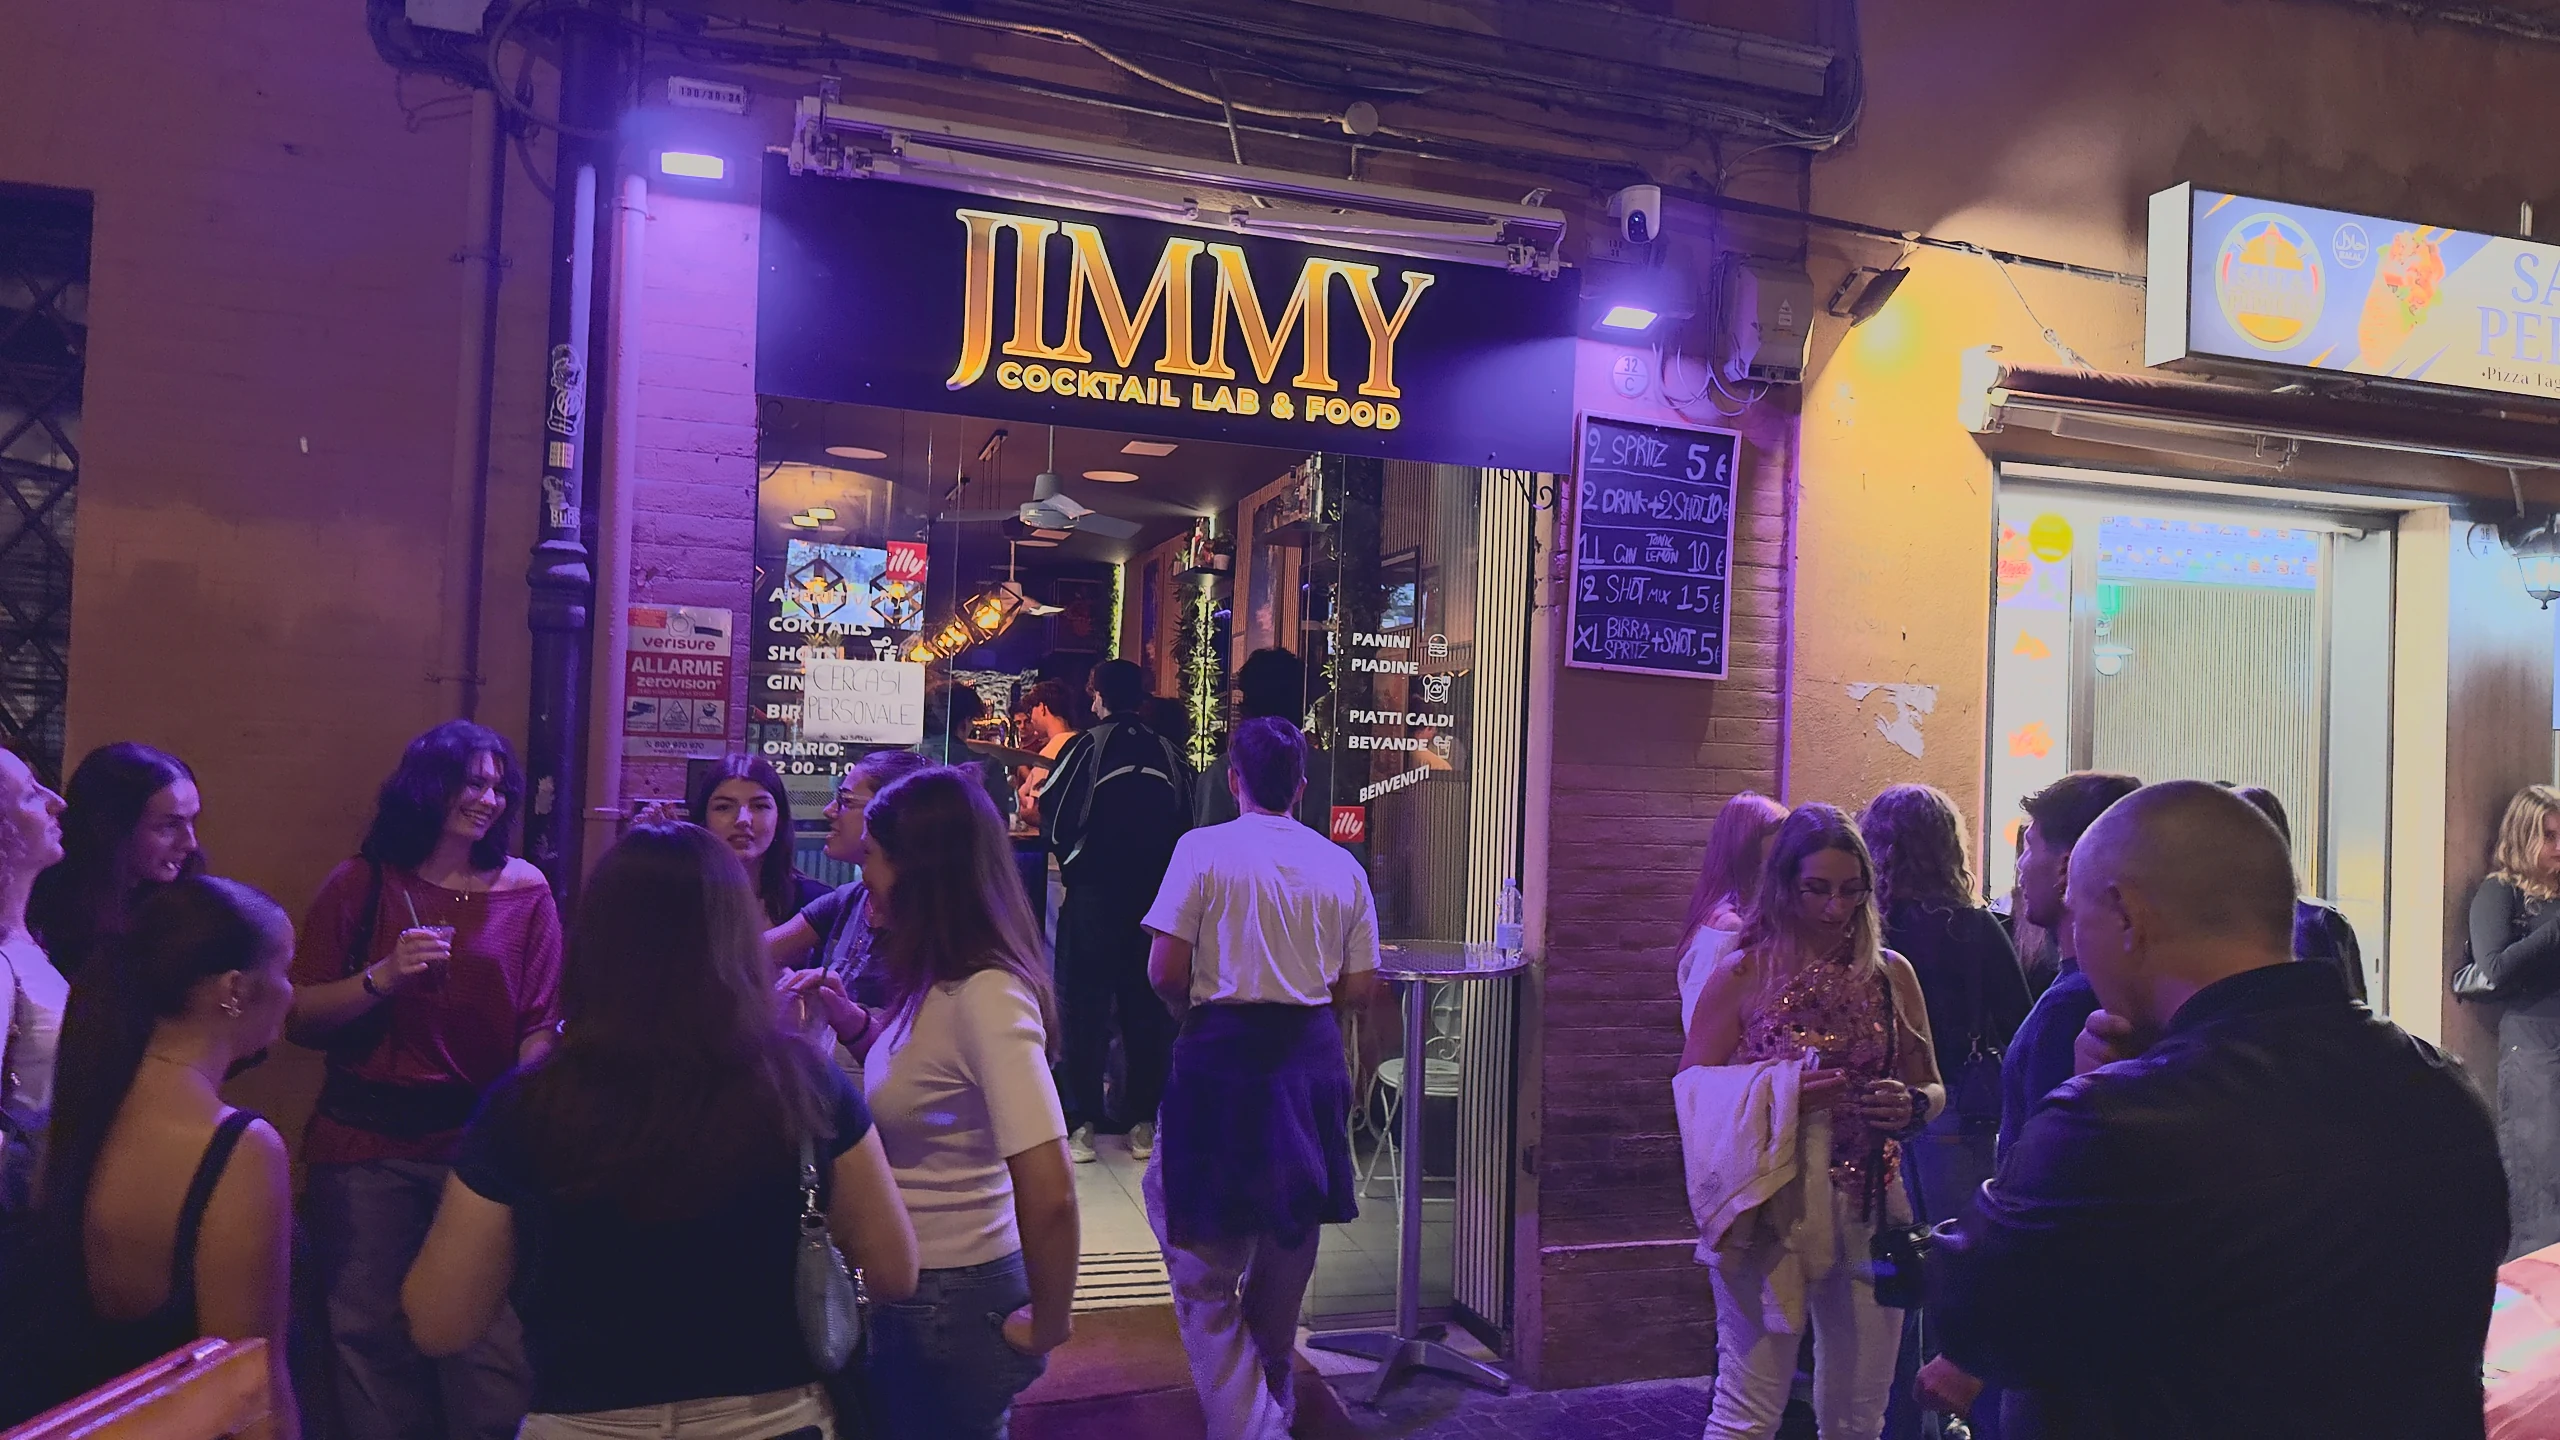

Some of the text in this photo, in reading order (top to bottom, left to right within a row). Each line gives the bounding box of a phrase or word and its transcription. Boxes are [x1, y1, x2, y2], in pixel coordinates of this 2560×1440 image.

[946, 208, 1436, 400] JIMMY
[1624, 357, 1638, 373] 32
[1625, 376, 1635, 392] C
[2487, 366, 2529, 385] Pizza
[996, 361, 1402, 432] COCKTAIL LAB & FOOD
[1587, 427, 1728, 482] 2 SPRITZ 5 €
[1582, 480, 1599, 511] 2
[1613, 543, 1638, 565] GIN
[1645, 532, 1675, 548] TONIC
[1687, 540, 1710, 573] 10
[1645, 550, 1680, 564] LEMON
[2482, 544, 2489, 556] A
[889, 548, 926, 578] illy
[1605, 573, 1651, 606] SHOT
[1647, 587, 1672, 606] MIX
[768, 617, 872, 637] COKTAILS
[642, 637, 716, 651] verisure
[1352, 632, 1411, 649] PANINI
[1574, 622, 1603, 653] XL
[1605, 615, 1651, 641] BIRRA
[1697, 631, 1717, 666] 5
[1604, 640, 1651, 661] SPRITZ
[632, 656, 724, 677] ALLARME
[1351, 658, 1419, 675] PIADINE
[767, 674, 804, 691] GIN
[812, 664, 903, 695] CERCASI
[766, 704, 803, 720] BIR
[807, 696, 917, 726] PERSONALE
[1350, 710, 1454, 728] PIATTI CALDI
[763, 741, 845, 756] ORARIO:
[1348, 736, 1429, 751] BEVANDE
[1359, 764, 1430, 803] BENVENUTI
[1333, 812, 1363, 838] illy
